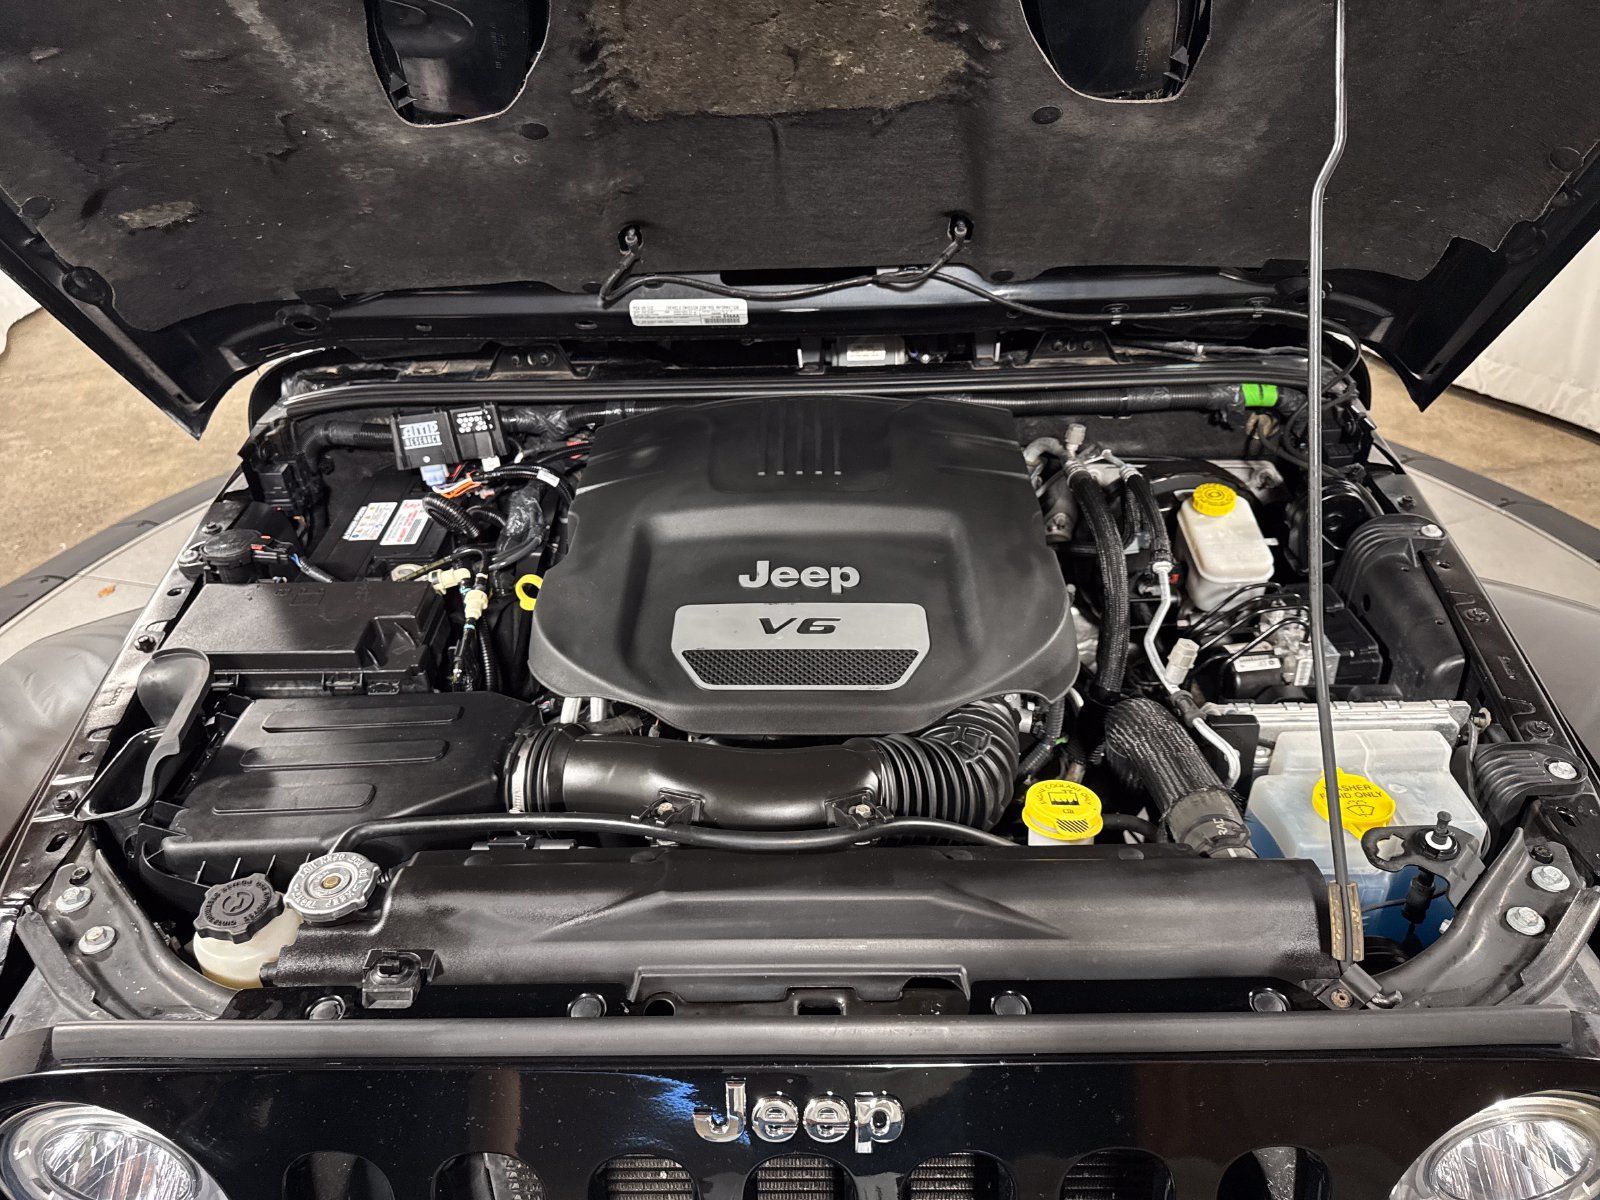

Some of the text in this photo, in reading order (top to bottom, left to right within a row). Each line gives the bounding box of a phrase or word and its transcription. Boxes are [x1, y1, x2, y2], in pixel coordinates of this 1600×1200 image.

[404, 434, 441, 447] RESEARCH
[738, 560, 860, 593] Jeep
[759, 617, 842, 635] V6
[1354, 791, 1384, 799] ONLY
[692, 1077, 906, 1154] Jeep
